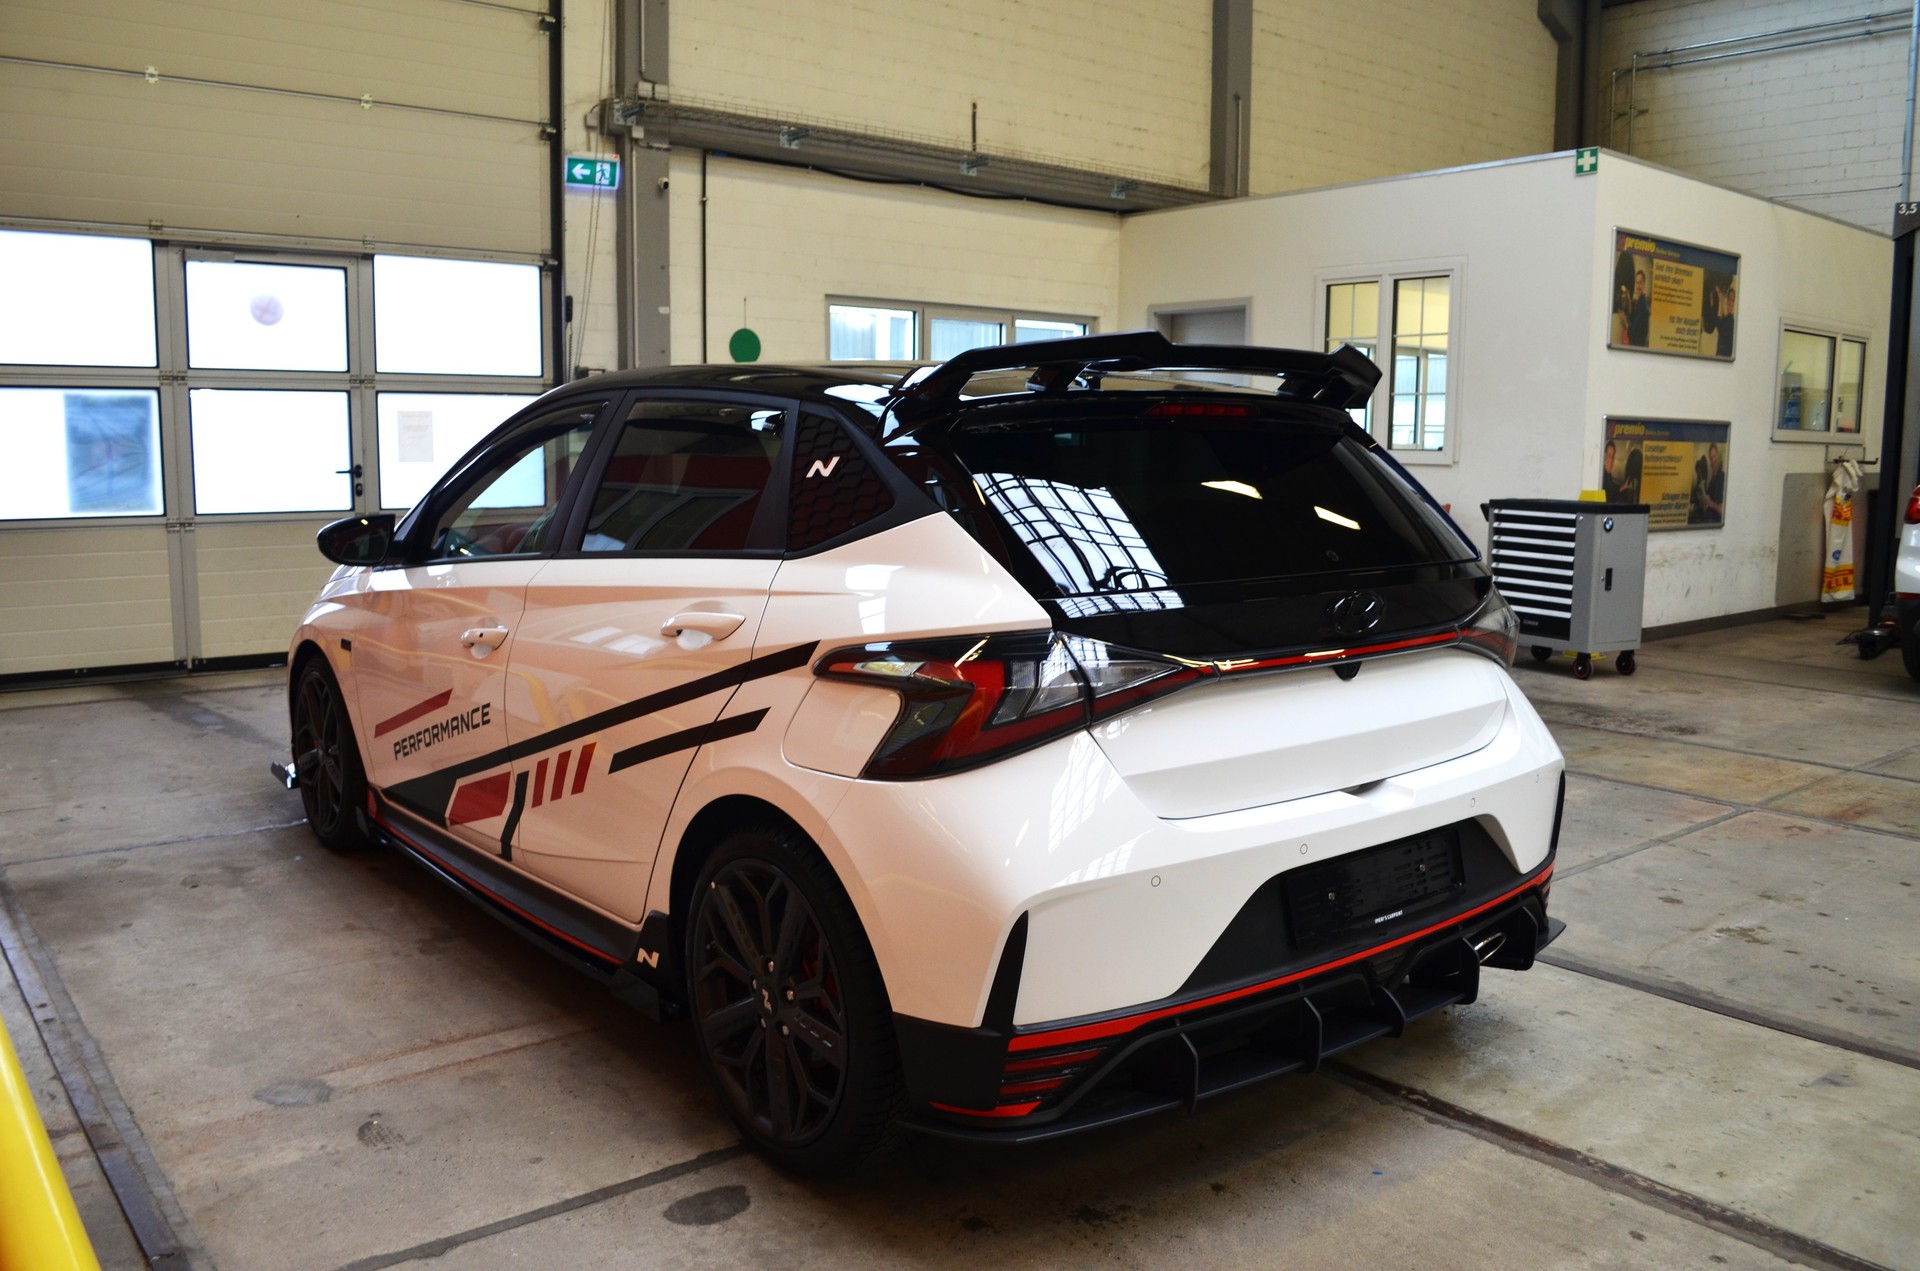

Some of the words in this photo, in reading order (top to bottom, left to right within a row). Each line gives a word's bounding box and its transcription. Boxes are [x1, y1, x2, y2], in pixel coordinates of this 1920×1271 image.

[1898, 203, 1918, 215] 3,5
[1624, 236, 1656, 253] premio
[1614, 423, 1646, 437] premio
[806, 456, 840, 478] N
[393, 702, 491, 761] PERFORMANCE
[637, 947, 660, 969] N
